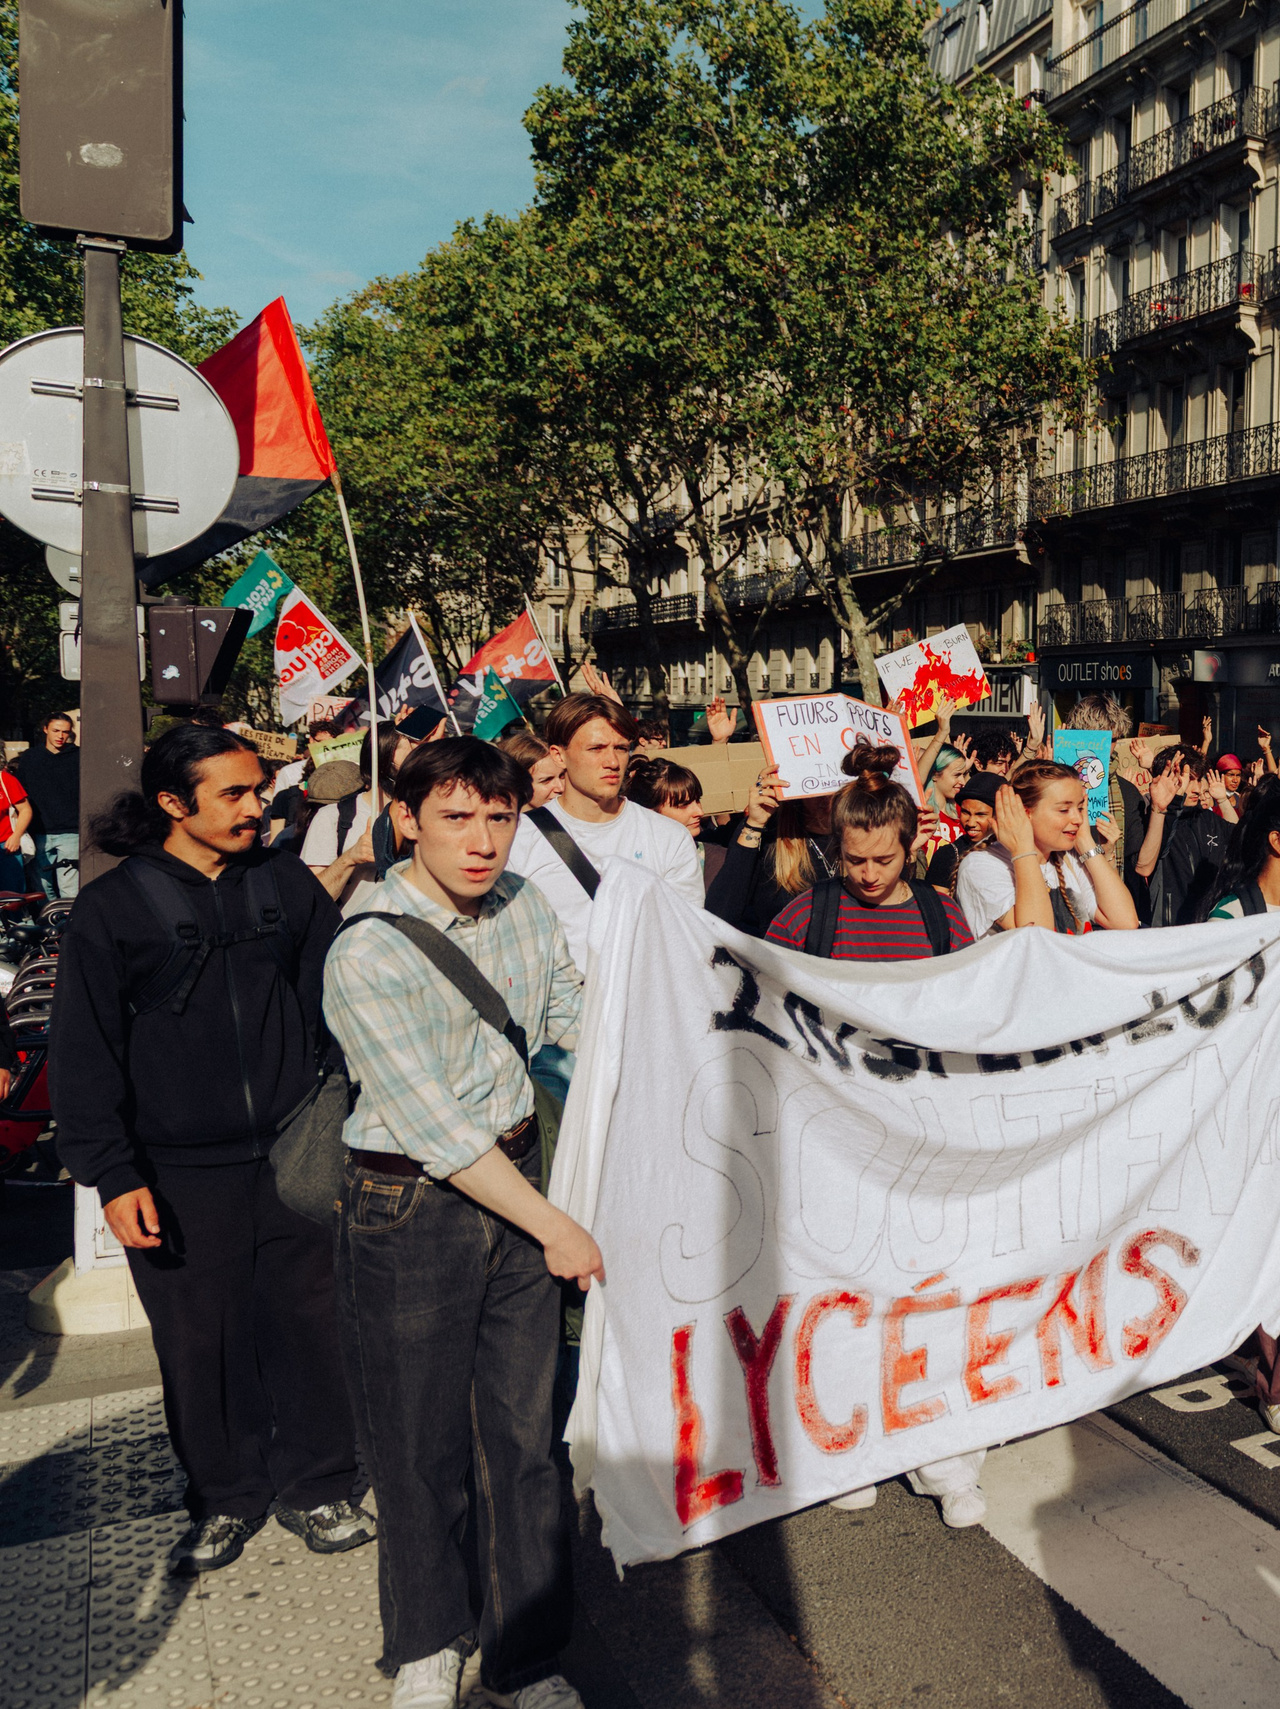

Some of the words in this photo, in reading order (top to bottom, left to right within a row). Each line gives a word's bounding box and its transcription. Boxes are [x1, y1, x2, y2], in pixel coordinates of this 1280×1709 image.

[881, 661, 892, 675] IF
[894, 653, 914, 669] WE
[943, 632, 969, 649] BURN
[1058, 662, 1100, 682] OUTLET
[1100, 661, 1132, 682] shoes
[776, 701, 839, 728] FUTURS
[847, 702, 893, 737] PROFS
[276, 735, 286, 746] DE
[788, 733, 822, 757] EN
[670, 1226, 1201, 1533] LYCÉENS
